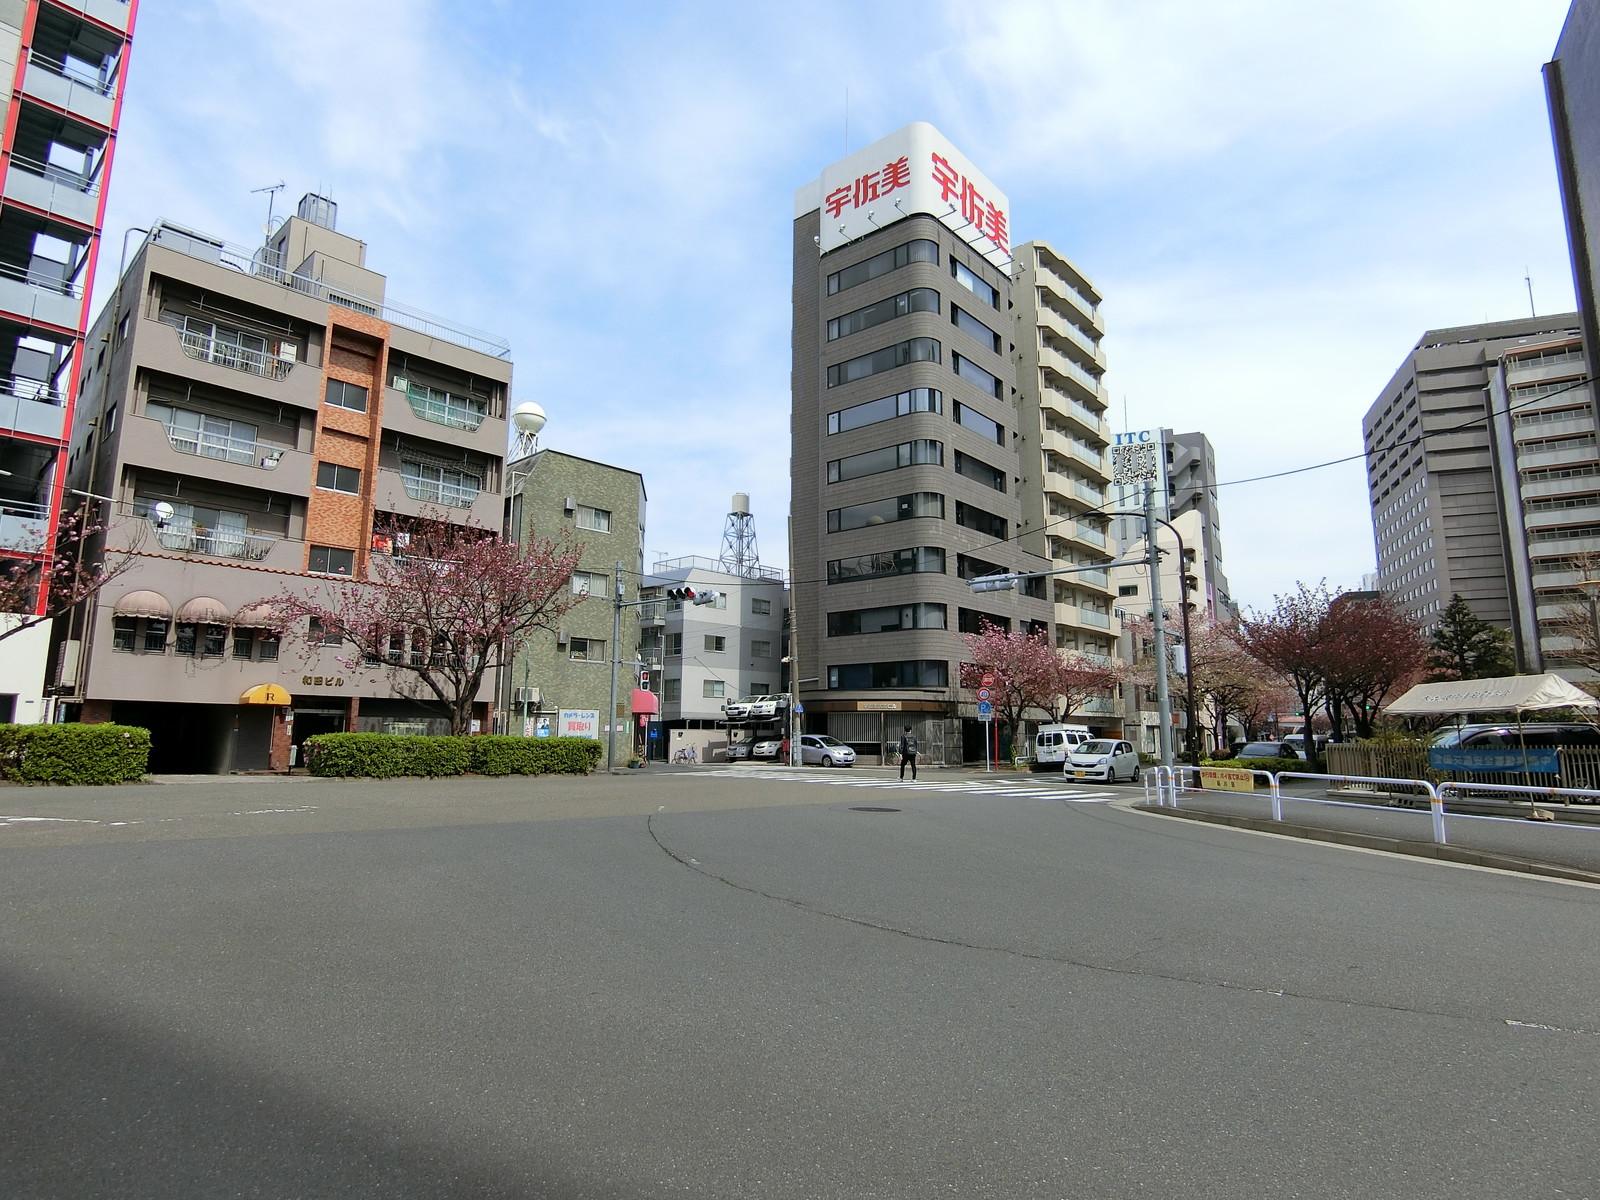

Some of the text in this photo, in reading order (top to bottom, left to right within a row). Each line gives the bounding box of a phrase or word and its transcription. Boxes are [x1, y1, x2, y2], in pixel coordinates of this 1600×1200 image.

[825, 156, 910, 218] 宇佐美
[931, 152, 1009, 254] 宇佐美
[1115, 430, 1151, 446] ITC
[302, 675, 344, 687] 和田ビル
[568, 721, 591, 732] 買取り
